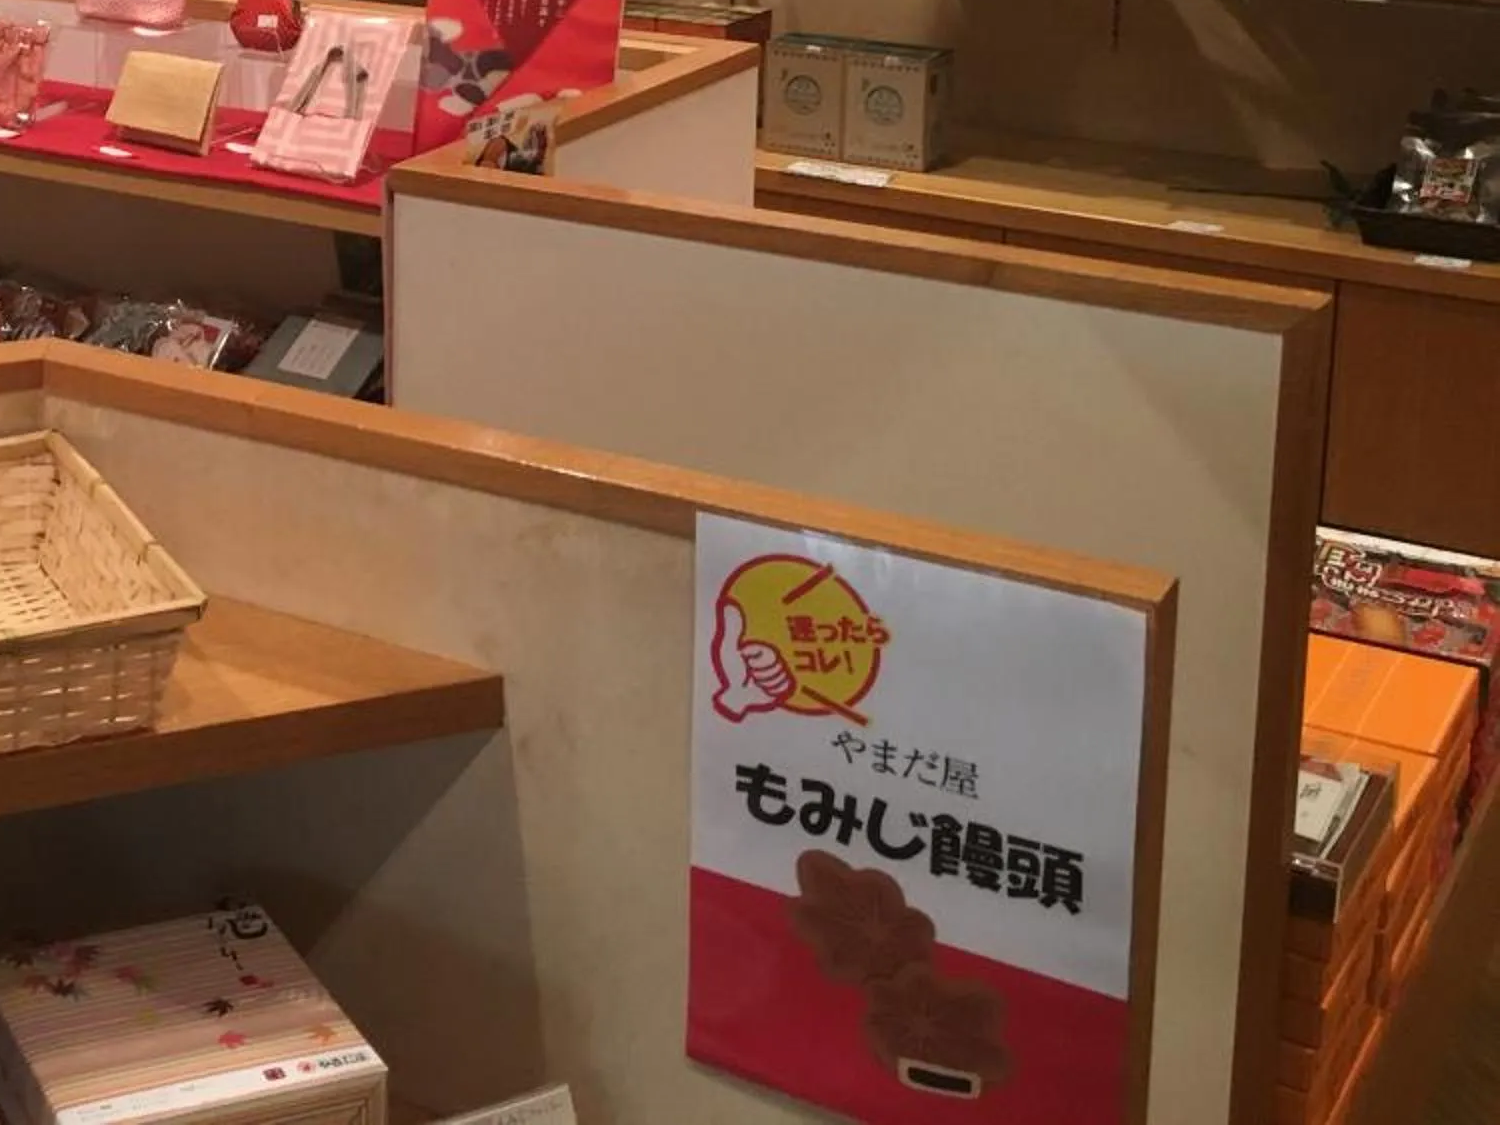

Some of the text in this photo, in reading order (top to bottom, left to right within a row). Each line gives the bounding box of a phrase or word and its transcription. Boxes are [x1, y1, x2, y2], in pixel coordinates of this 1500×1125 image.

[786, 615, 891, 646] 迷ったら
[794, 650, 854, 676] コレ!
[830, 730, 981, 801] やまだ屋
[734, 762, 1084, 916] もみじ饅頭
